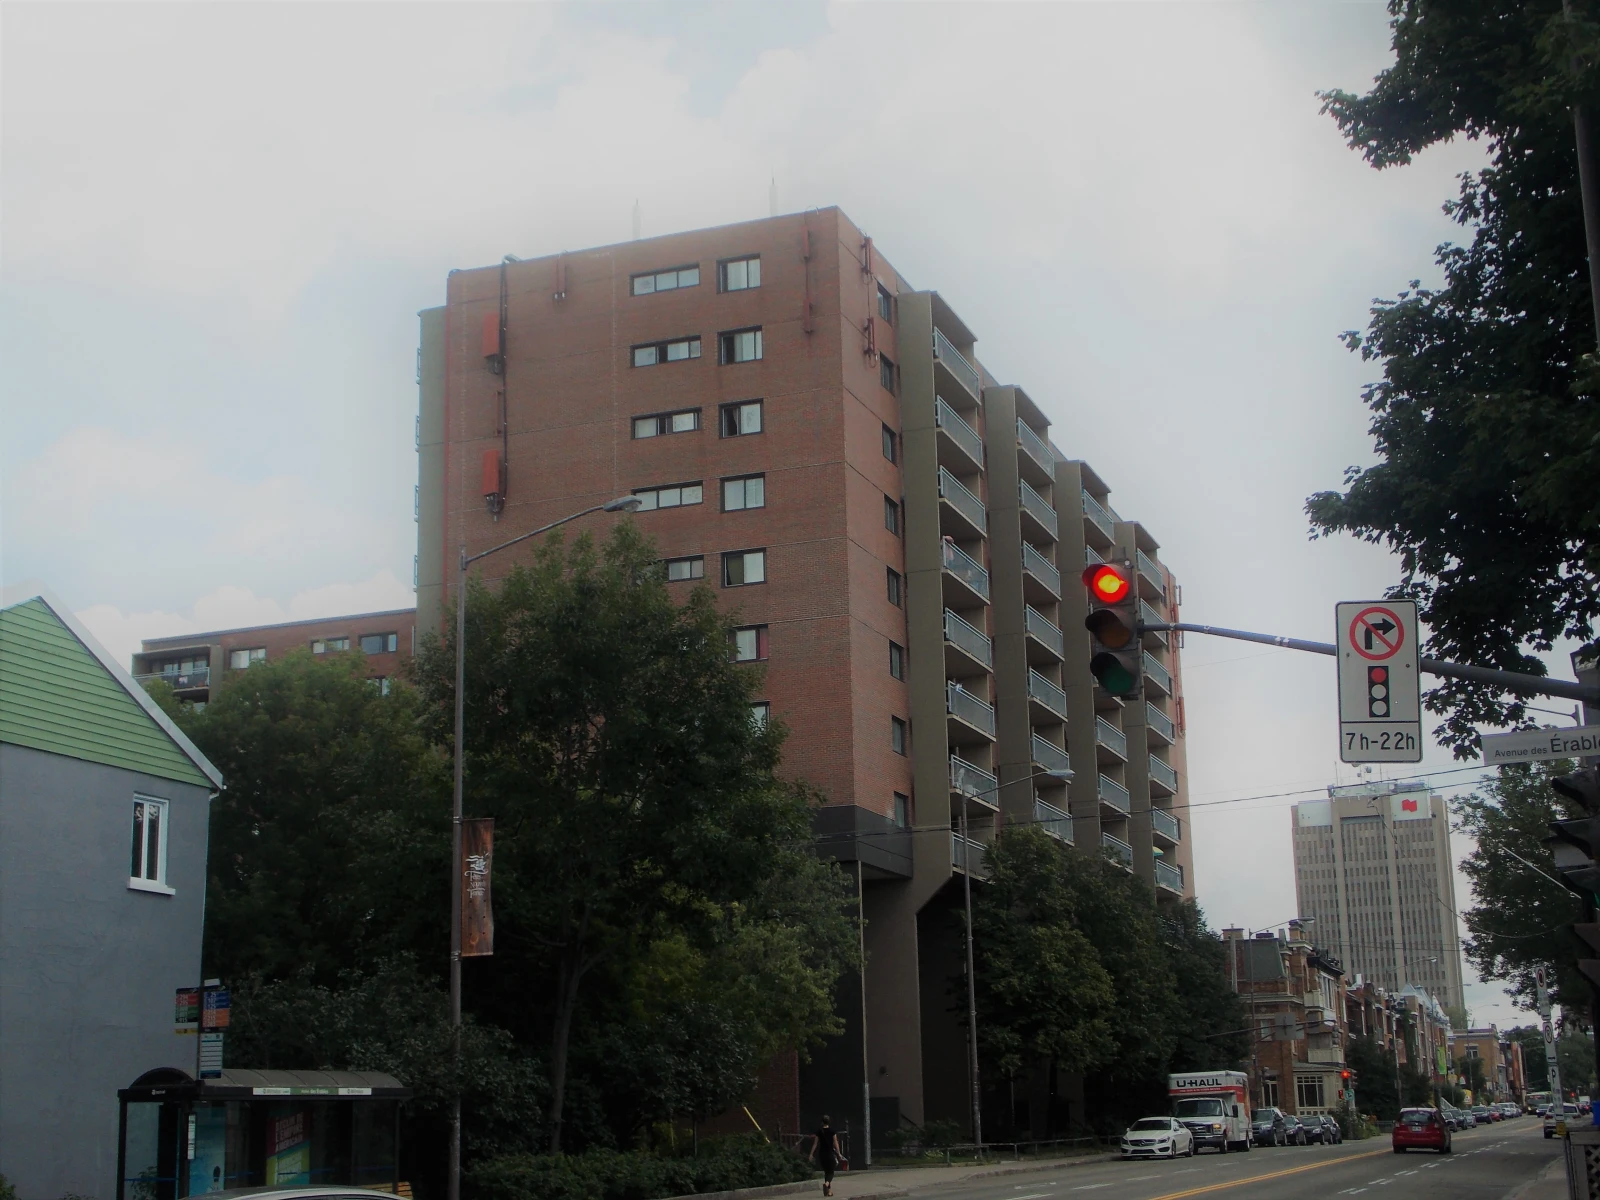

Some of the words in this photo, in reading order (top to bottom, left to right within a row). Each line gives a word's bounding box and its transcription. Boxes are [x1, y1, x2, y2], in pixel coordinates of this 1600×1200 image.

[1495, 749, 1528, 757] Avenue
[1530, 746, 1548, 755] des
[1550, 734, 1600, 753] Érabl
[1176, 1079, 1222, 1087] U-HAUL
